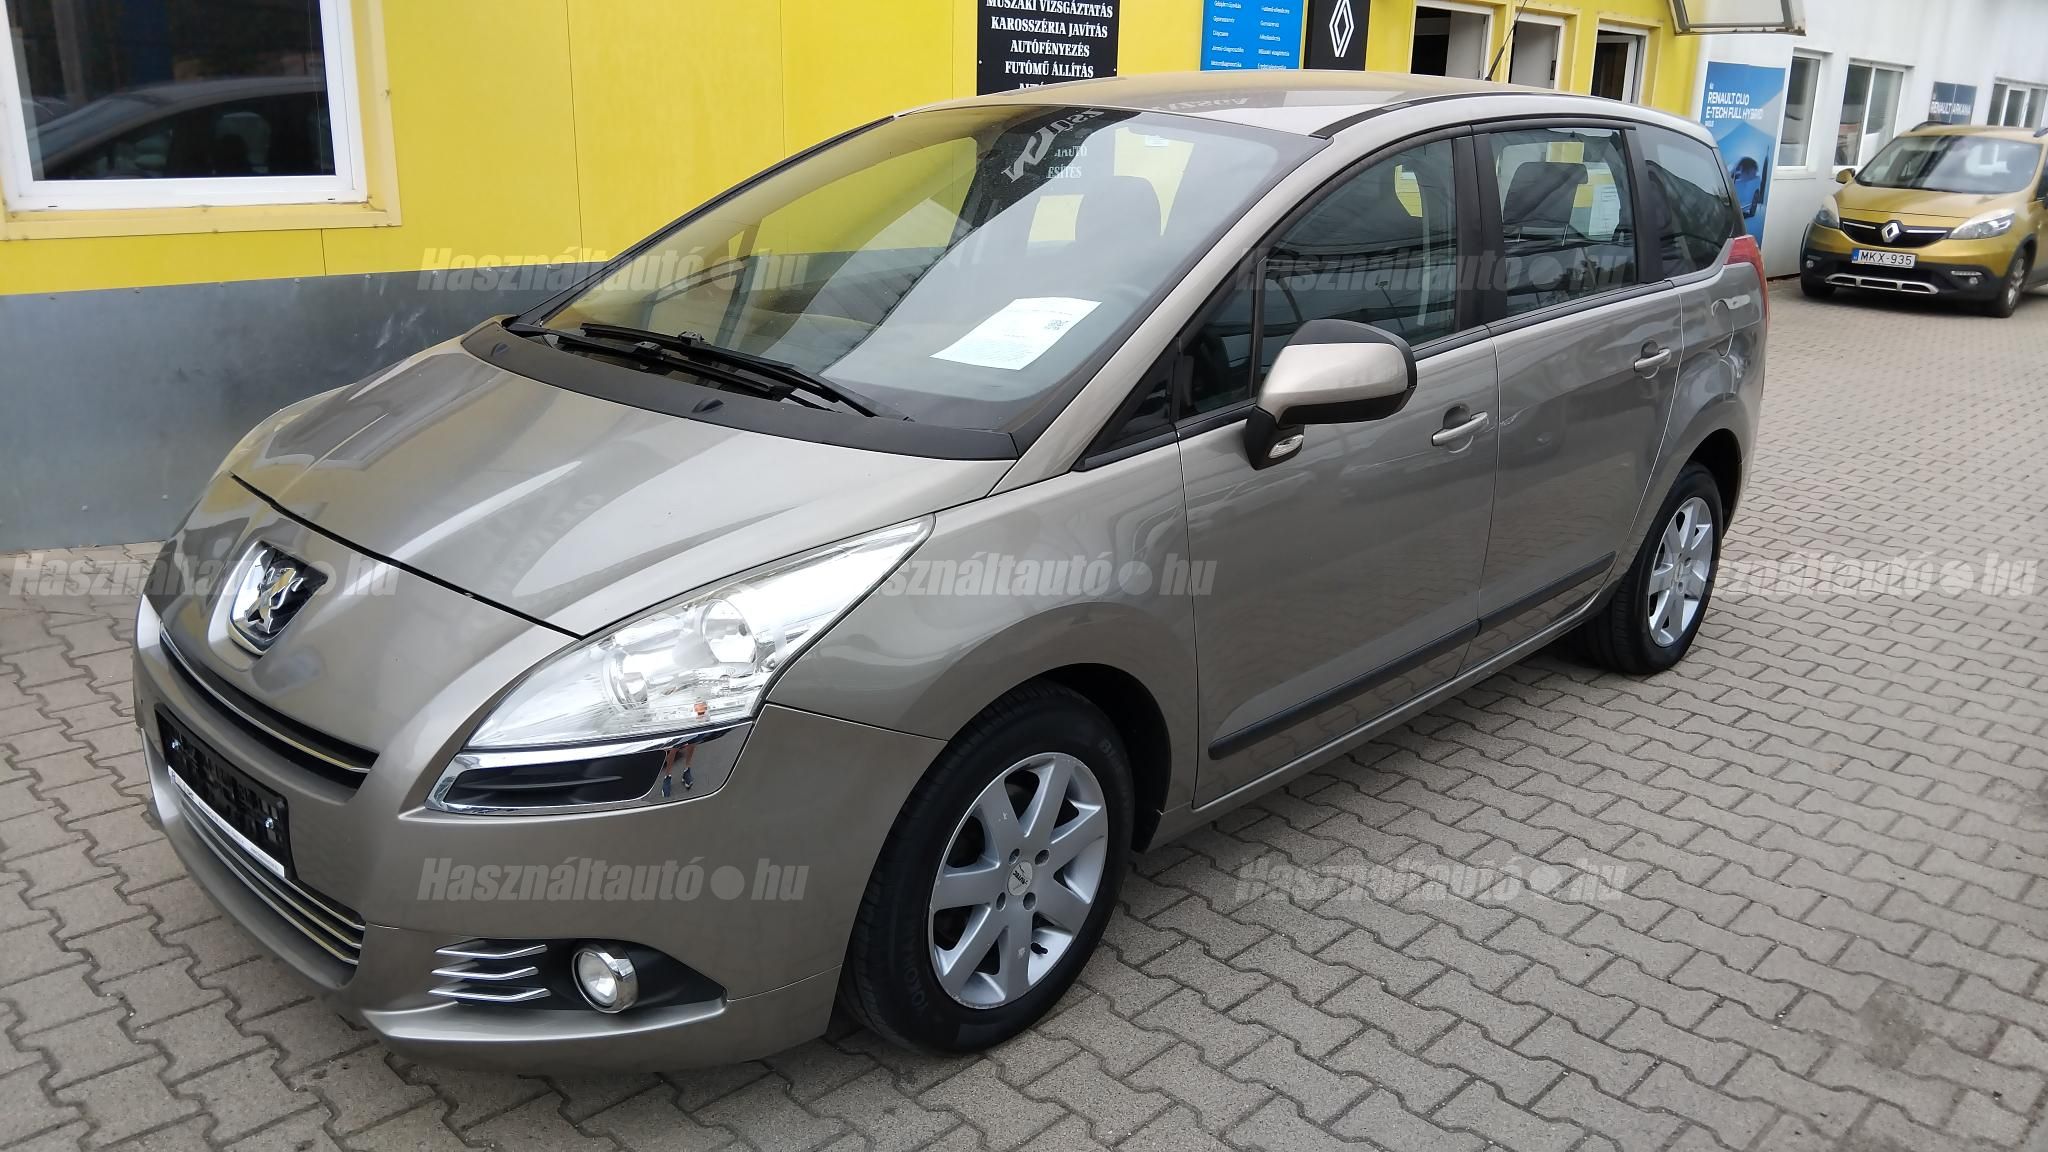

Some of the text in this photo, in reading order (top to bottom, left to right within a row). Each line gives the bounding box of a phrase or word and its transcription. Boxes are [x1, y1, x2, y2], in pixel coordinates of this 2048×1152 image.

[1040, 0, 1113, 18] VIZSGÁZTATÁS
[991, 16, 1108, 38] KAROSSZÉRIA JAVÍTÁS
[1010, 39, 1090, 57] AUTÓFÉNYEZÉS
[1004, 60, 1094, 78] FUTÓMŰ ÁLLÍTÁS
[1707, 91, 1750, 106] RENAULT CLIO
[1705, 106, 1728, 118] E-TECH
[1728, 107, 1742, 119] FULL
[1861, 252, 1912, 265] MKX-935
